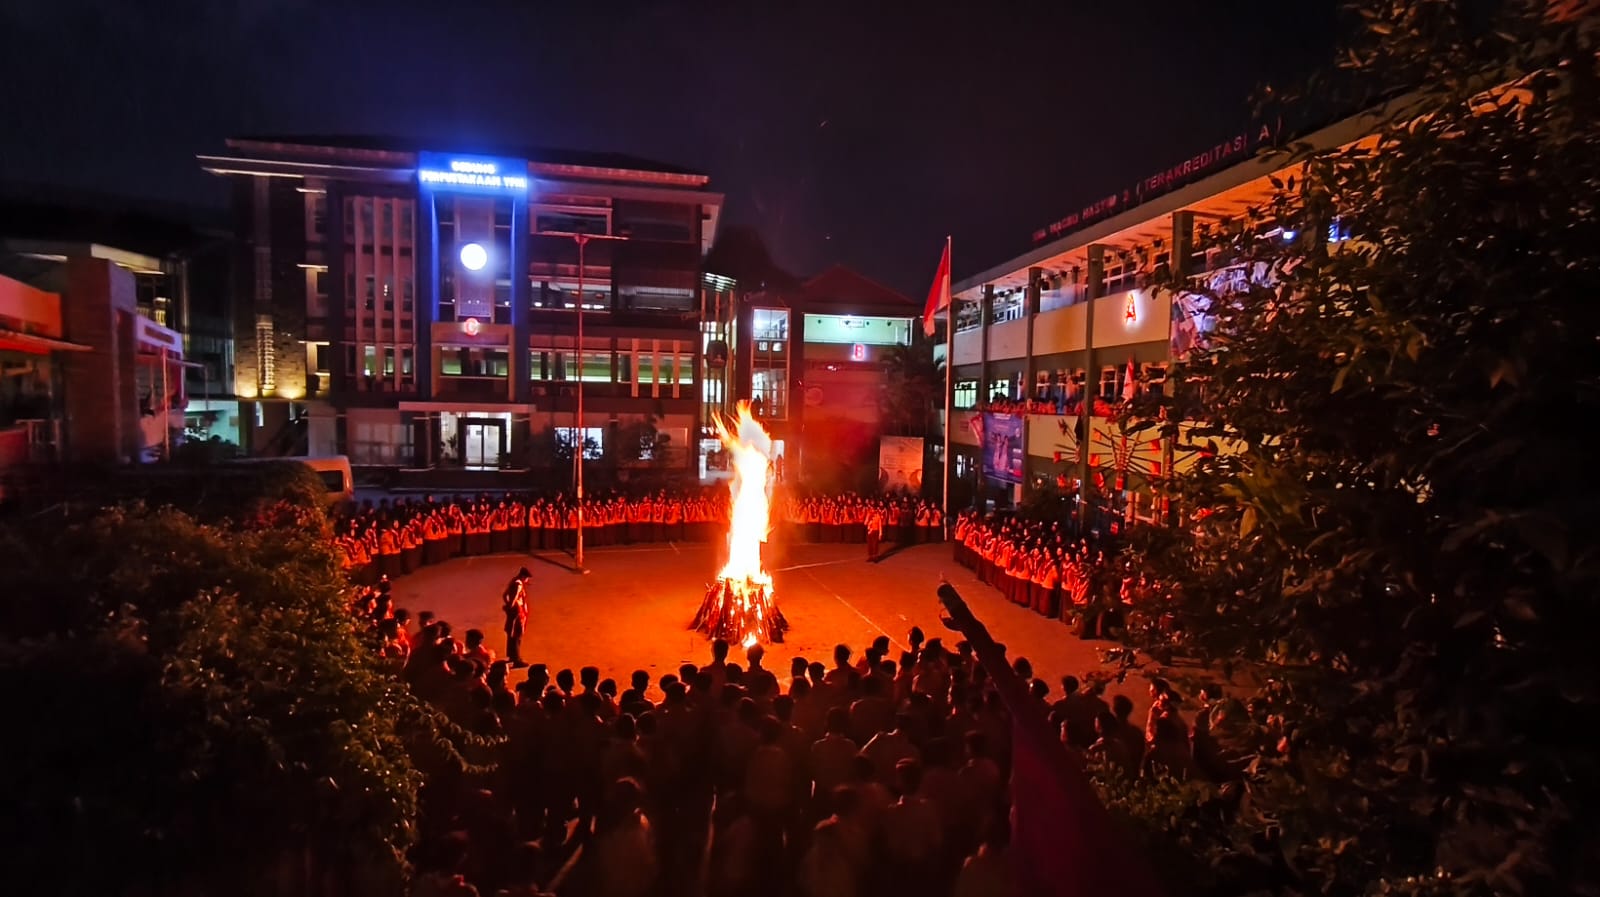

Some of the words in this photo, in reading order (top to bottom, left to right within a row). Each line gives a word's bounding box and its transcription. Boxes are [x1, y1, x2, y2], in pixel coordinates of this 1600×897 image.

[1124, 291, 1138, 325] A
[464, 317, 480, 336] C
[853, 342, 866, 362] B
